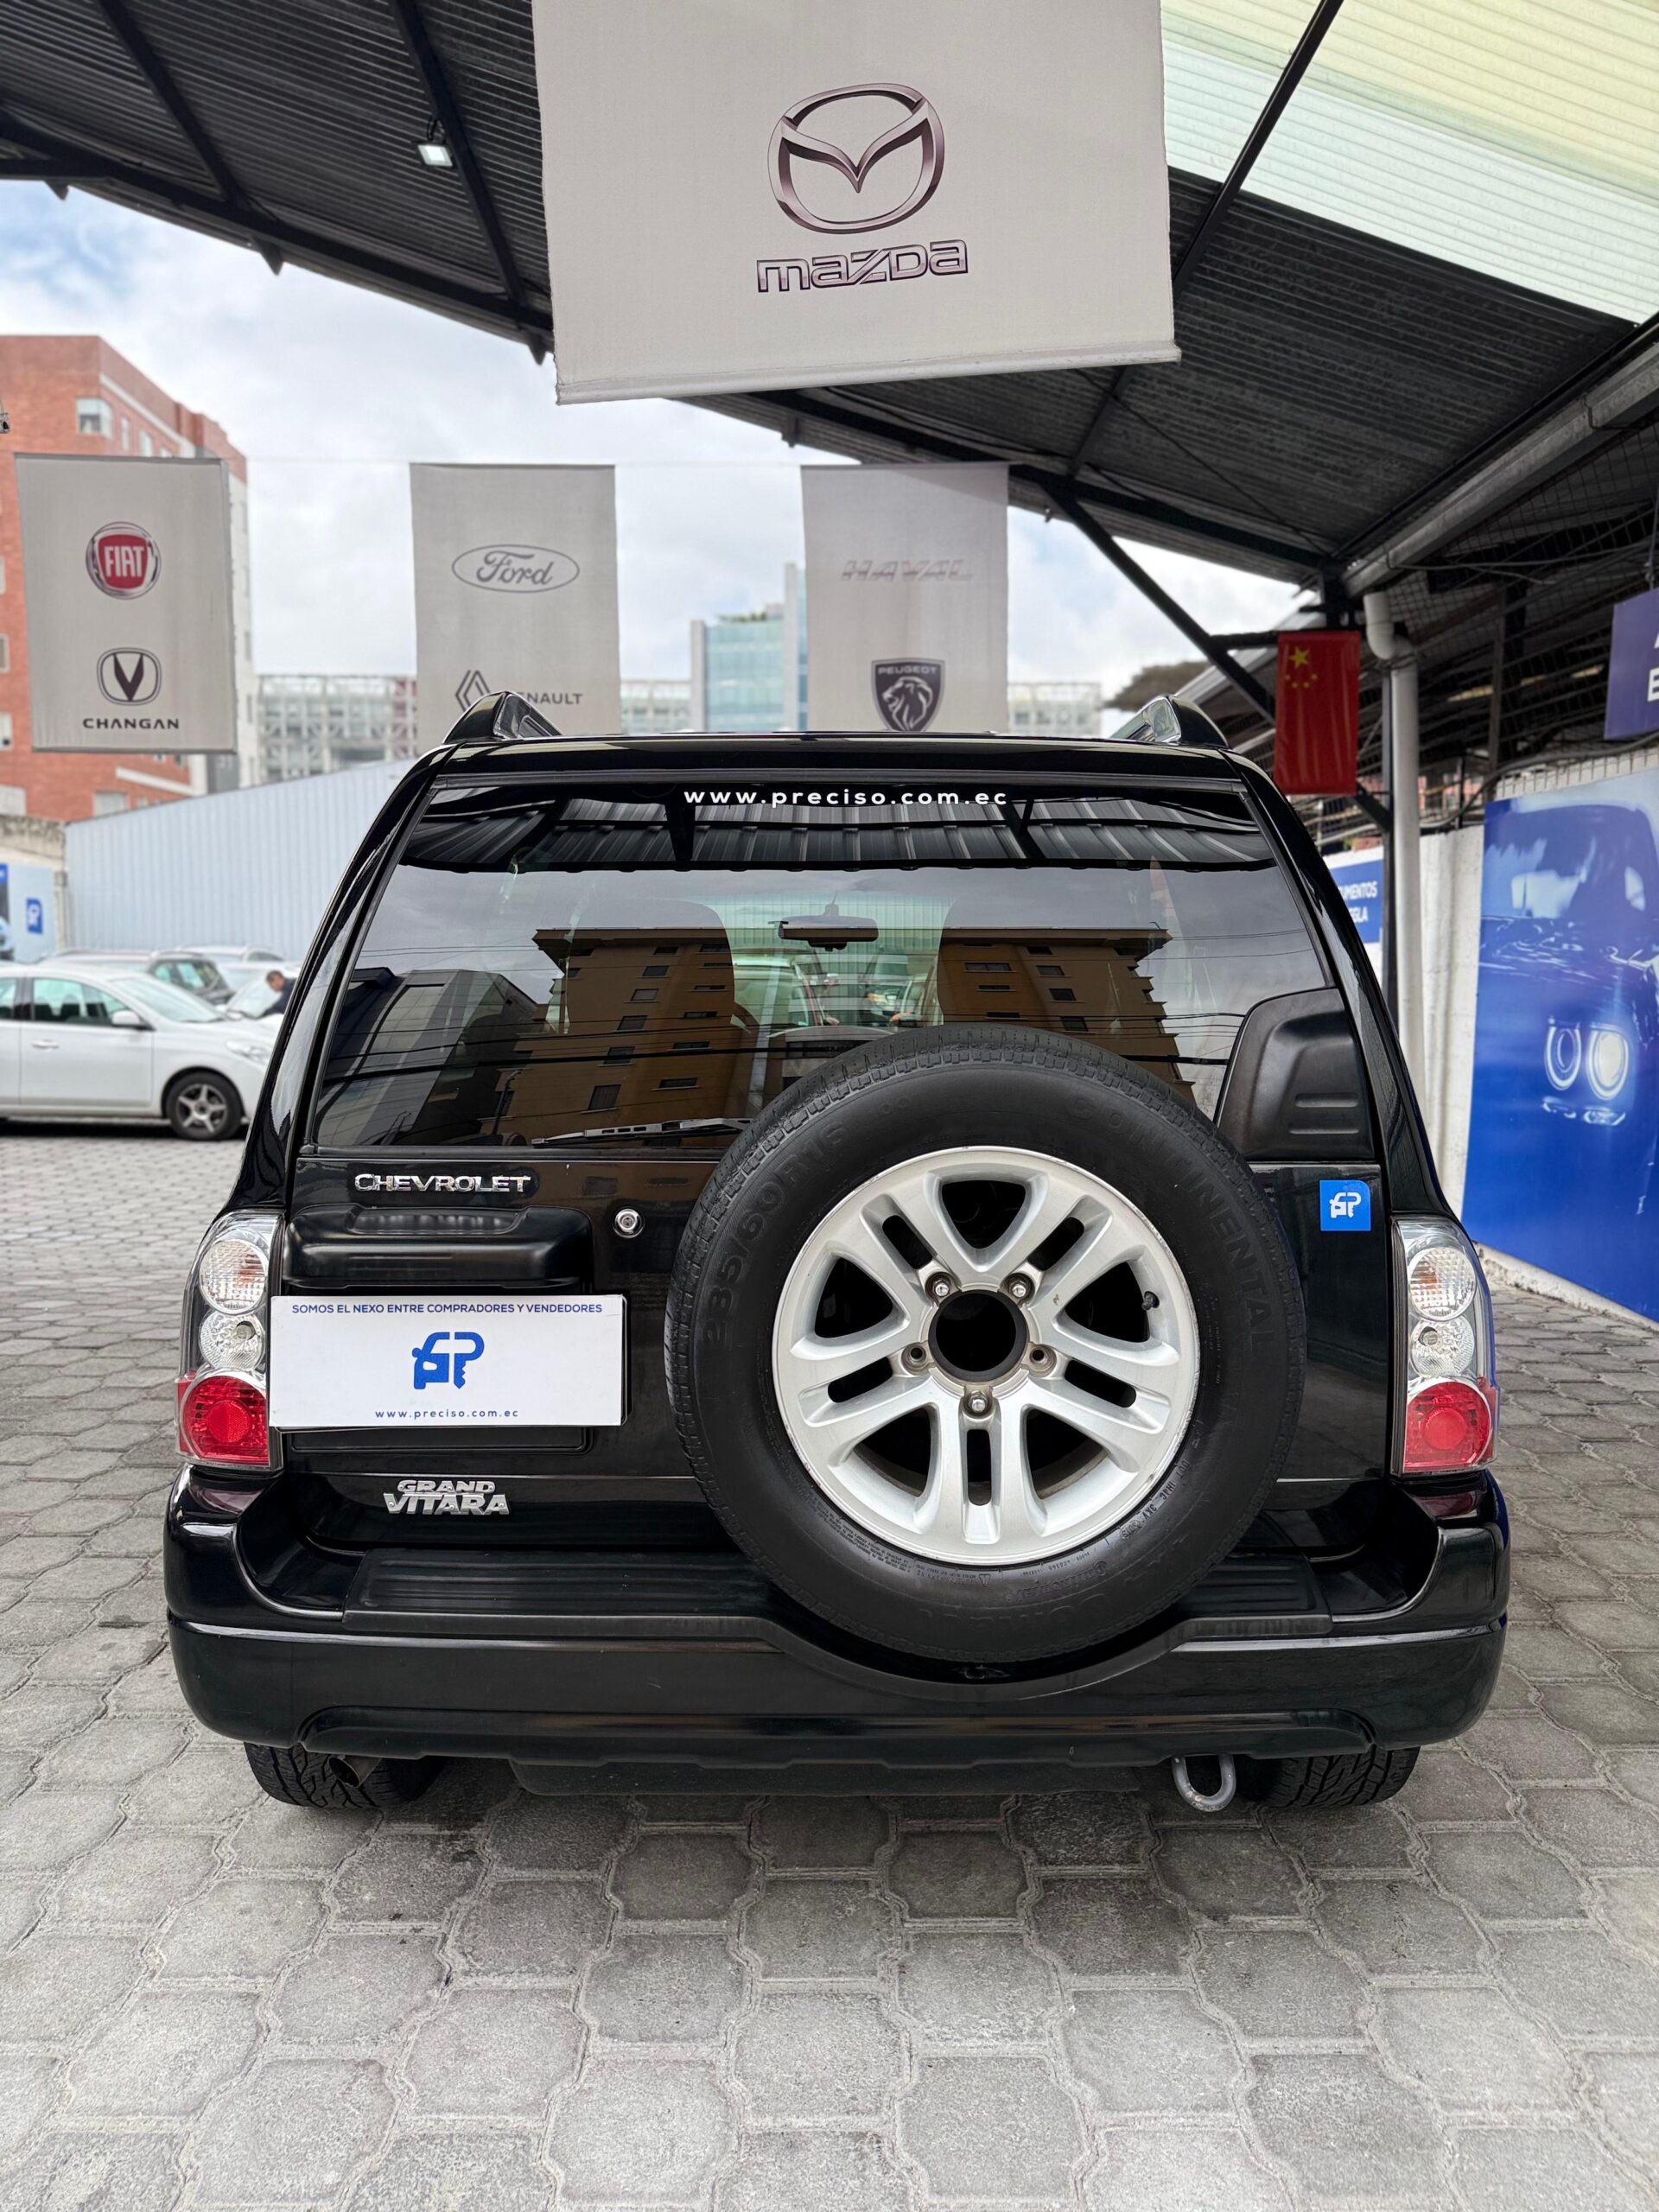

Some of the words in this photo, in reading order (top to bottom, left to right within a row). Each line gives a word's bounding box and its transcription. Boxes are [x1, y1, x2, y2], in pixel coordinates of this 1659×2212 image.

[104, 545, 145, 578] FIAT
[476, 550, 555, 585] Ford
[877, 665, 938, 675] PEUGEOT
[83, 718, 180, 729] CHANGAN
[683, 788, 1007, 809] www.preciso.com.ec
[354, 1173, 531, 1192] CHEVROLET
[292, 1303, 334, 1314] SOMOS
[337, 1303, 351, 1314] EL
[353, 1303, 385, 1314] NEXO
[387, 1303, 424, 1314] ENTRE
[427, 1303, 515, 1314] COMPRADORES
[517, 1303, 524, 1314] Y
[526, 1303, 603, 1314] VENDEDORES
[375, 1408, 518, 1420] www.preciso.com.ec
[397, 1479, 496, 1493] GRAND
[383, 1493, 510, 1515] VITARA
